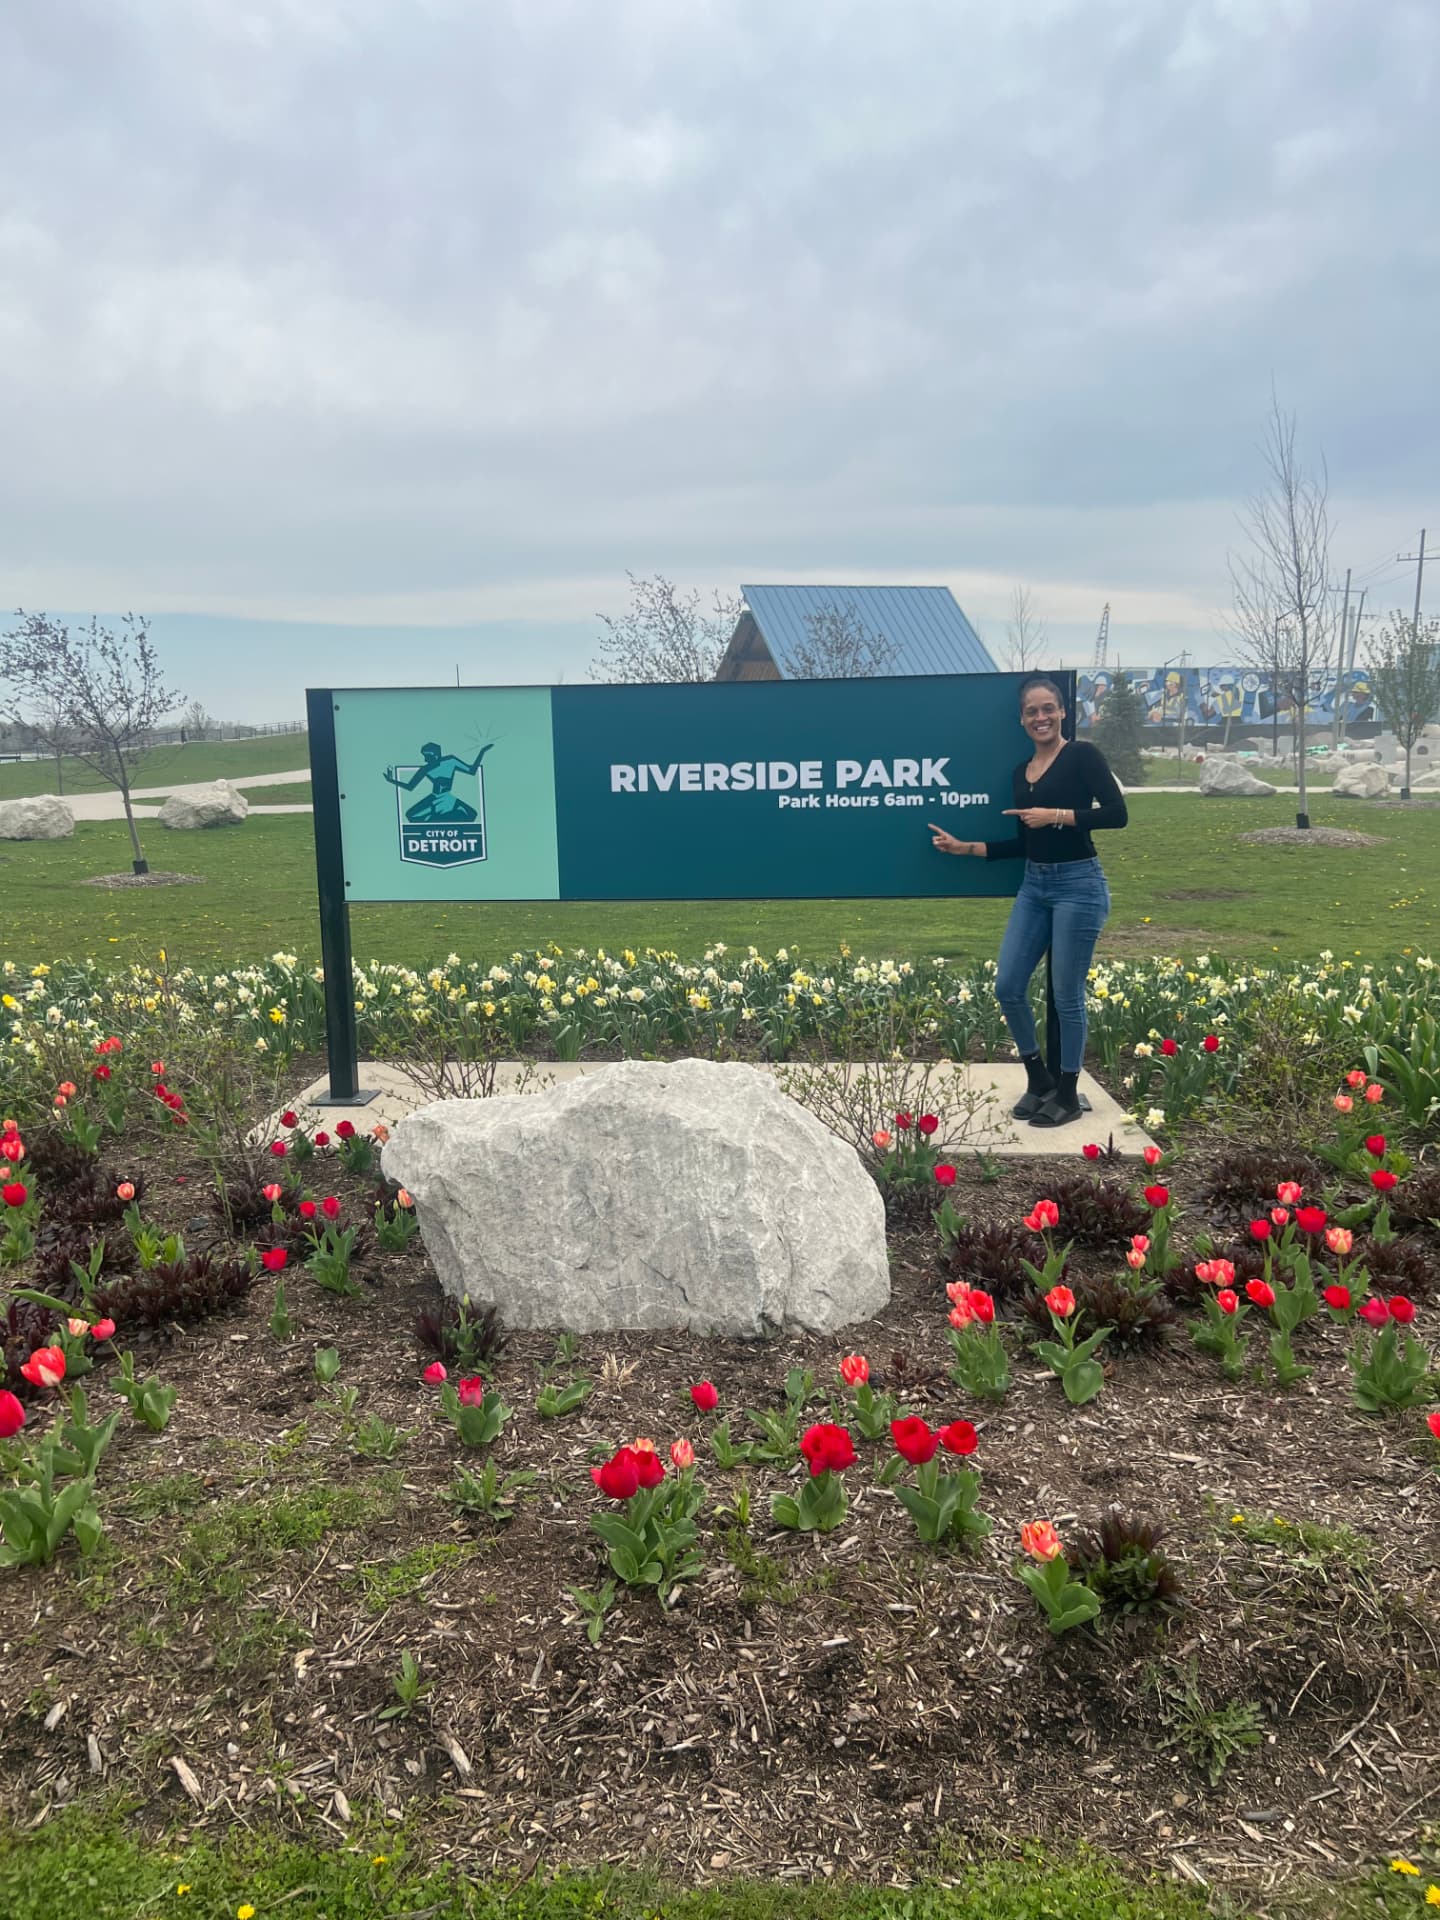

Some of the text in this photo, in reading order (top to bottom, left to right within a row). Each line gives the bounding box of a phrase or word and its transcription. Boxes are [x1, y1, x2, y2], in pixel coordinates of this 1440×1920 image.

[610, 757, 951, 792] RIVERSIDE PARK
[778, 794, 820, 808] Park
[825, 793, 879, 808] Hours
[884, 792, 924, 807] 6am
[940, 791, 990, 808] 10pm
[426, 830, 445, 838] CITY
[408, 839, 478, 852] DETROIT
